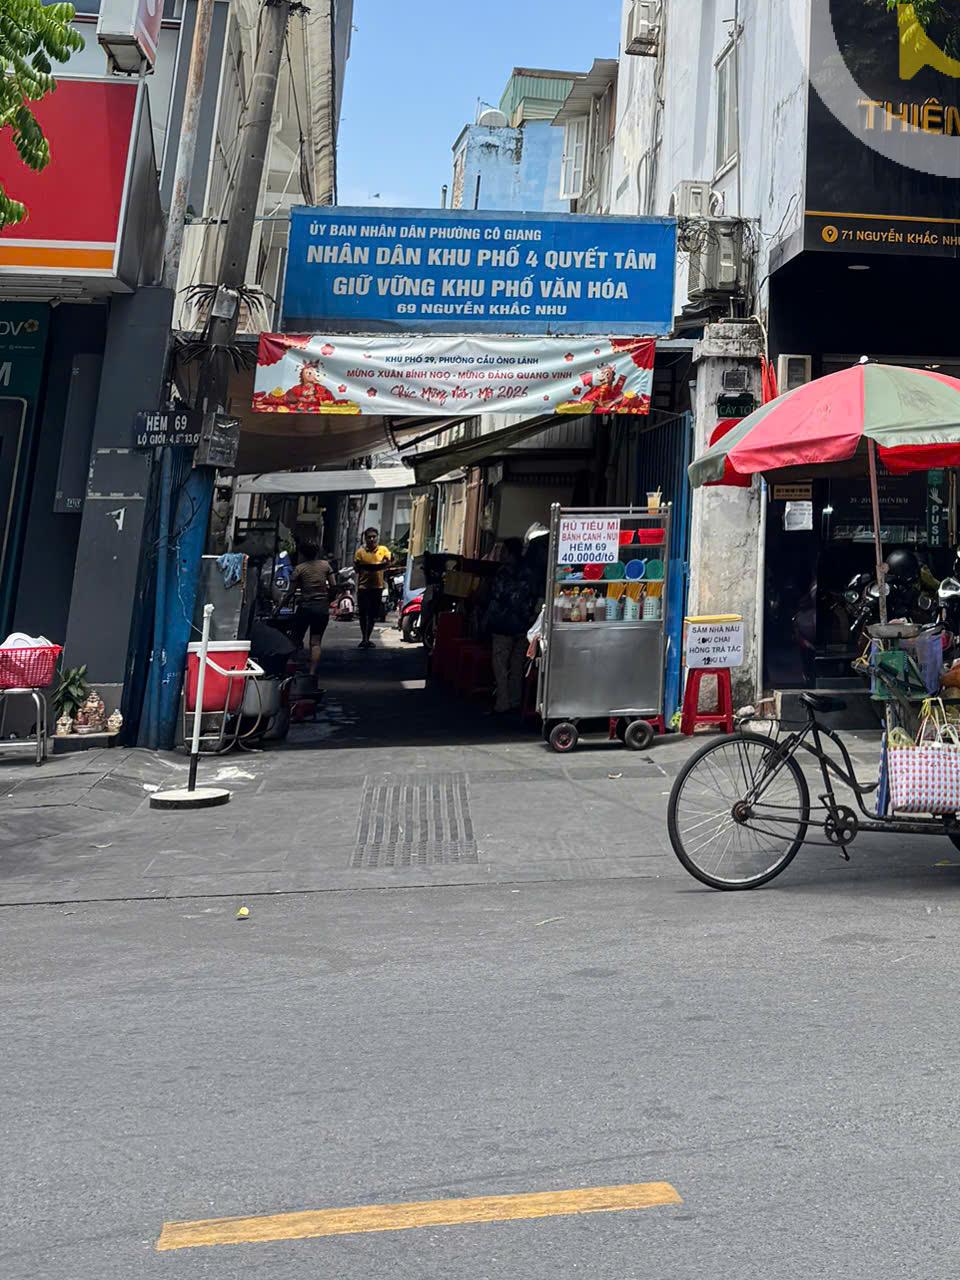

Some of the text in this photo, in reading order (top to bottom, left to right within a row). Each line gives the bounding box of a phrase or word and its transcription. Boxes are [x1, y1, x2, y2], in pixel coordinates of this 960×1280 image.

[309, 220, 542, 242] ỦY BAN NHÂN DÂN PHƯỜNG CÔ GIANG
[841, 230, 854, 241] 71
[856, 226, 906, 244] NGUYỄN
[307, 242, 657, 270] NHÂN DÂN KHU PHỐ 4 QUYẾT TÂM
[333, 274, 629, 300] GIỮ VỮNG KHU PHỐ VĂN HÓA
[397, 303, 418, 315] 69
[535, 304, 568, 316] NHU
[385, 356, 403, 364] KHU
[404, 354, 424, 364] PHỐ
[424, 356, 437, 365] 29,
[439, 355, 476, 365] PHƯỜNG
[496, 355, 516, 366] ÔNG
[346, 368, 375, 379] MỪNG
[377, 368, 404, 380] XUÂN
[406, 369, 429, 381] BÍNH
[430, 370, 451, 382] NGỌ
[458, 368, 487, 380] MỪNG
[517, 370, 551, 381] QUANG
[552, 370, 574, 380] VINH
[390, 383, 418, 399] Chúc
[497, 384, 529, 400] 2026
[174, 415, 188, 431] 69
[931, 504, 940, 545] PUSH
[595, 542, 607, 552] 69
[562, 552, 615, 563] 40.000đ/tô
[711, 644, 726, 654] TRÀ
